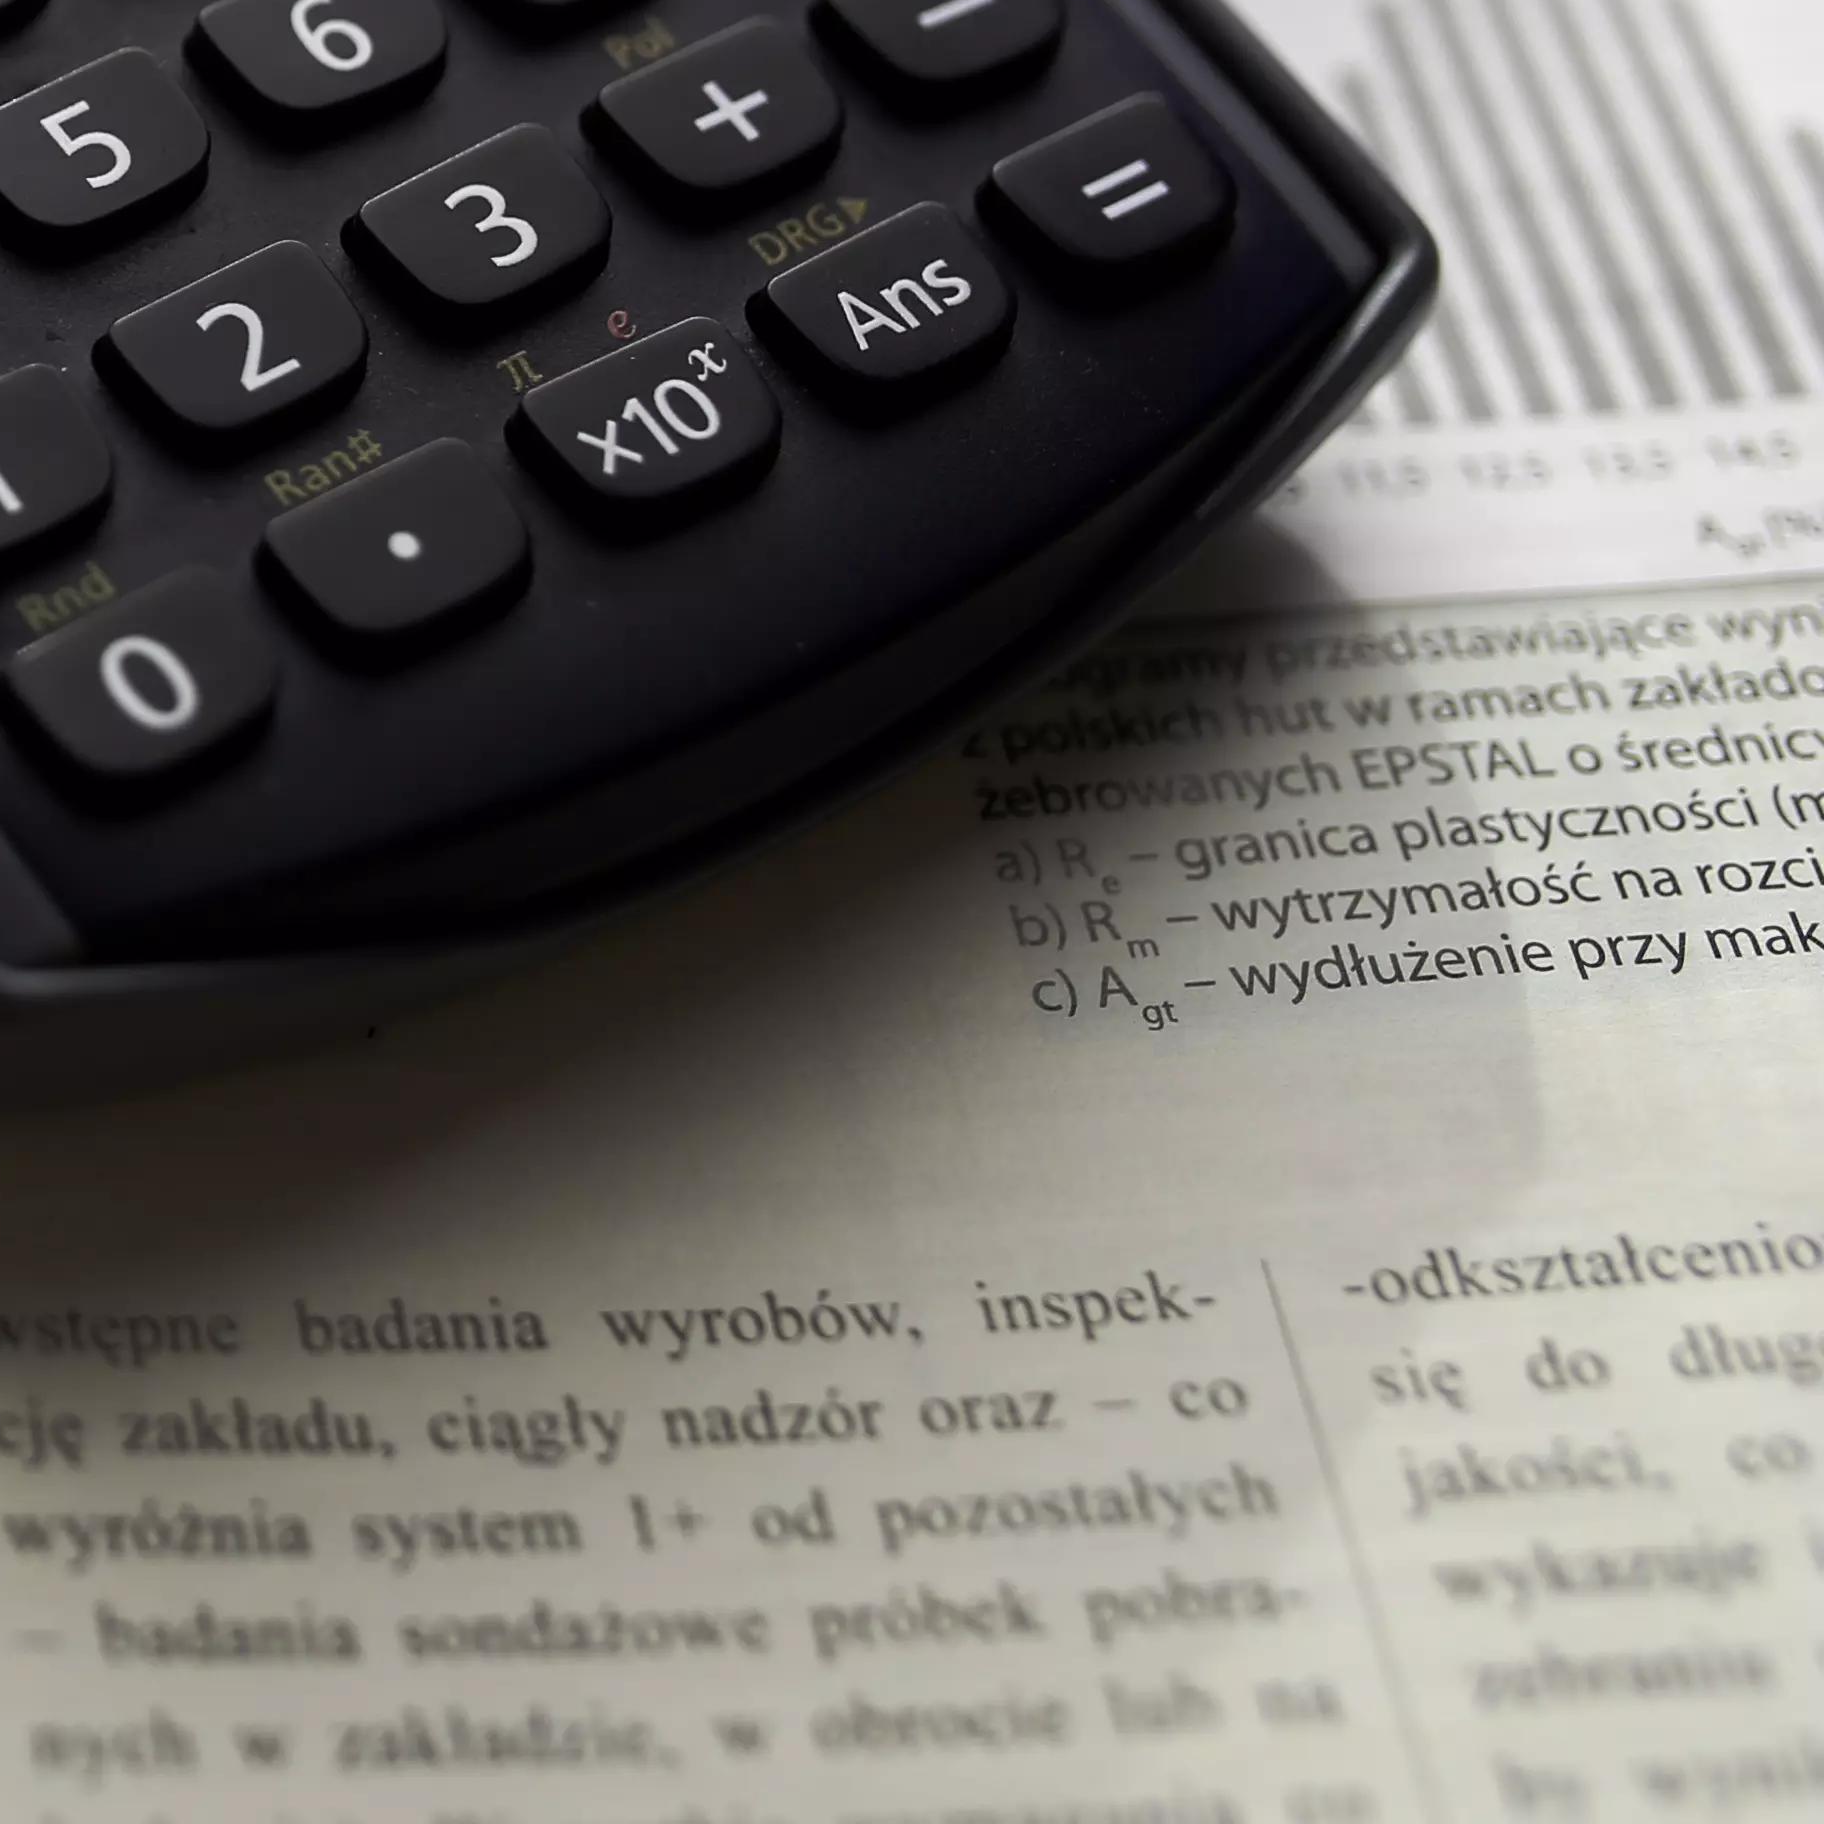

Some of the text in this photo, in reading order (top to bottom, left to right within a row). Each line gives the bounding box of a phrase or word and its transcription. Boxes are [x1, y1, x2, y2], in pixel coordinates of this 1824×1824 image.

[39, 99, 132, 190] 5
[444, 183, 540, 268] 3
[195, 301, 301, 393] 2
[836, 258, 972, 351] Ans
[264, 429, 385, 509] Ran#
[15, 560, 115, 632] Rnd
[100, 635, 201, 730] 0
[1266, 612, 1695, 683] przedstawiające
[1002, 703, 1220, 765] polskich
[1238, 695, 1336, 737] hut
[1343, 695, 1394, 728] w
[1407, 670, 1611, 724] ramach
[974, 751, 1344, 822] żebrowanych
[1351, 737, 1557, 793] EPSTAL
[1567, 743, 1603, 775] o
[995, 841, 1041, 885] a)
[1174, 818, 1379, 881] granica
[1393, 787, 1759, 861] plastyczności
[1009, 903, 1066, 951] b)
[1211, 860, 1600, 939] wytrzymałość
[1613, 866, 1682, 899] na
[1031, 968, 1078, 1018] c)
[1229, 933, 1555, 1005] wydłużenie
[1568, 930, 1688, 980] przy
[1343, 1221, 1824, 1306] -odkształcenio
[293, 1297, 548, 1356] badania
[599, 1288, 925, 1363] wyrobów,
[974, 1269, 1217, 1341] inspek-
[1370, 1336, 1612, 1412] się do
[118, 1395, 397, 1459] zakładu,
[426, 1393, 628, 1467] ciągły
[662, 1387, 886, 1451] nadzór
[918, 1387, 1063, 1437] oraz
[1169, 1377, 1248, 1420] co
[2, 1496, 314, 1576] wyróżnia
[352, 1504, 583, 1576] system
[752, 1483, 835, 1548] od
[875, 1460, 1280, 1558] pozostałych
[1396, 1429, 1816, 1519] jakości, co
[93, 1600, 364, 1667] badania
[808, 1580, 1050, 1663] próbek
